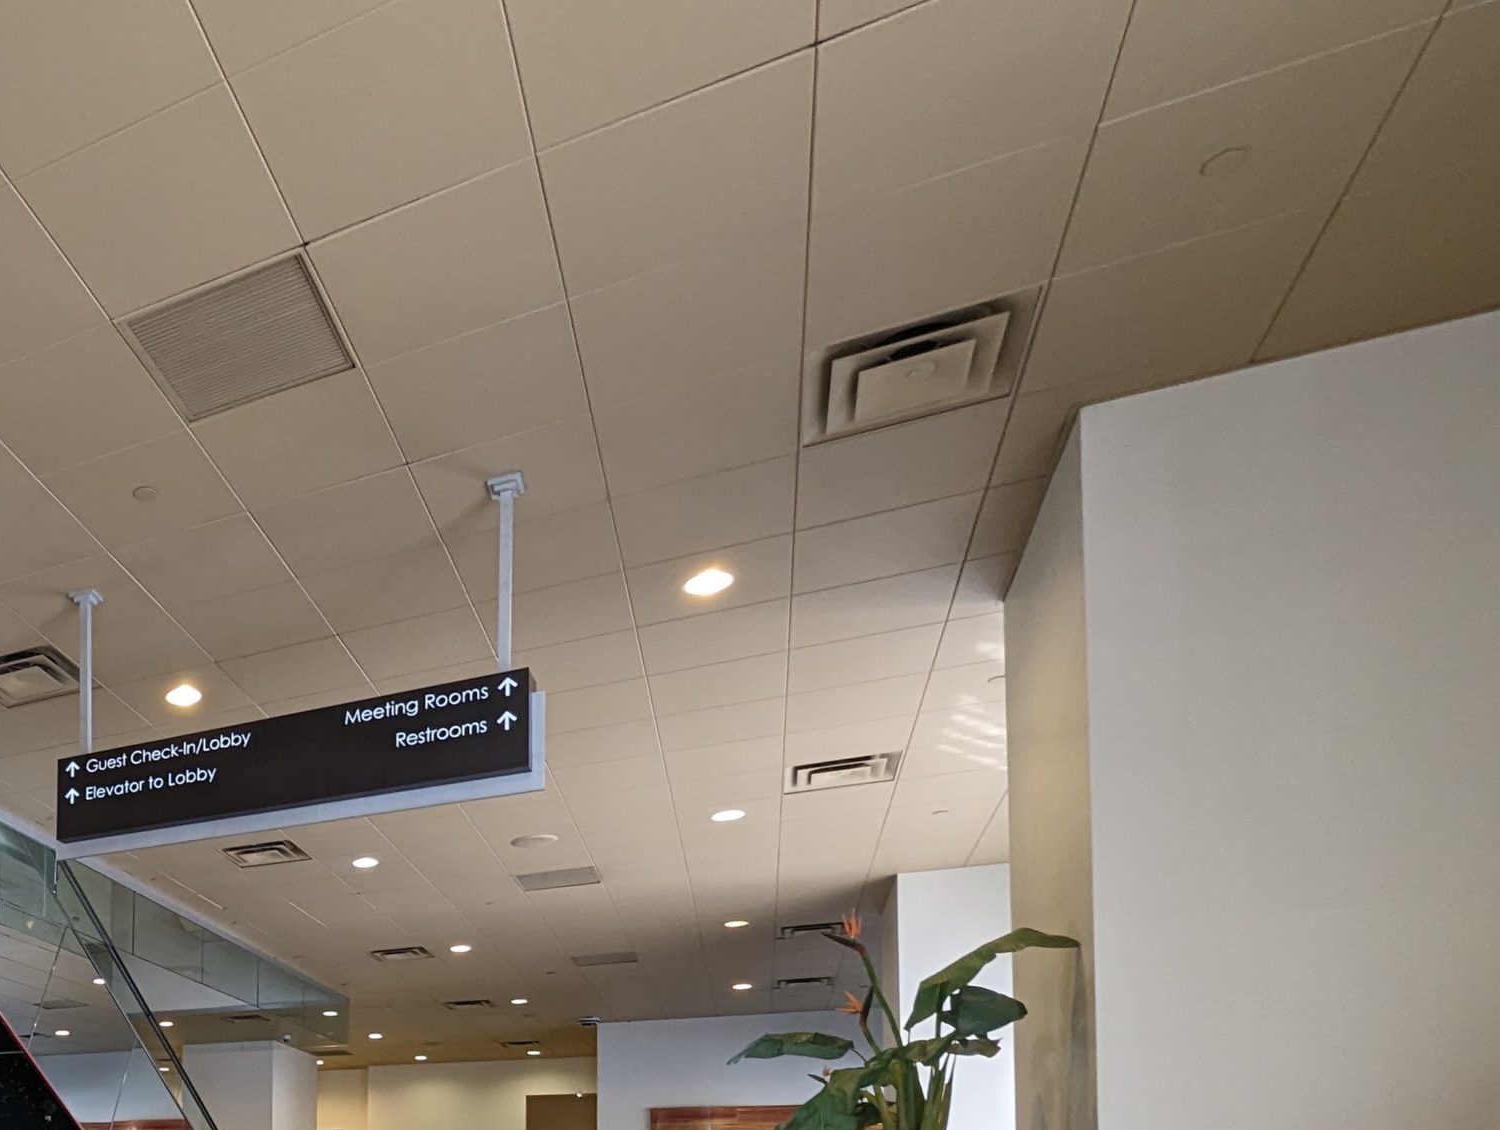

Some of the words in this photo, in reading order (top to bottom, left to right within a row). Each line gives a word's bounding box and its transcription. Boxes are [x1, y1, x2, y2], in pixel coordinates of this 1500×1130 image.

[344, 699, 419, 725] Meeting
[424, 686, 489, 710] Rooms
[395, 720, 488, 748] Restrooms
[86, 754, 127, 773] Guest
[130, 732, 251, 765] Check-In/Lobby
[85, 779, 145, 800] Elevator
[149, 776, 164, 790] to
[168, 768, 217, 787] Lobby
